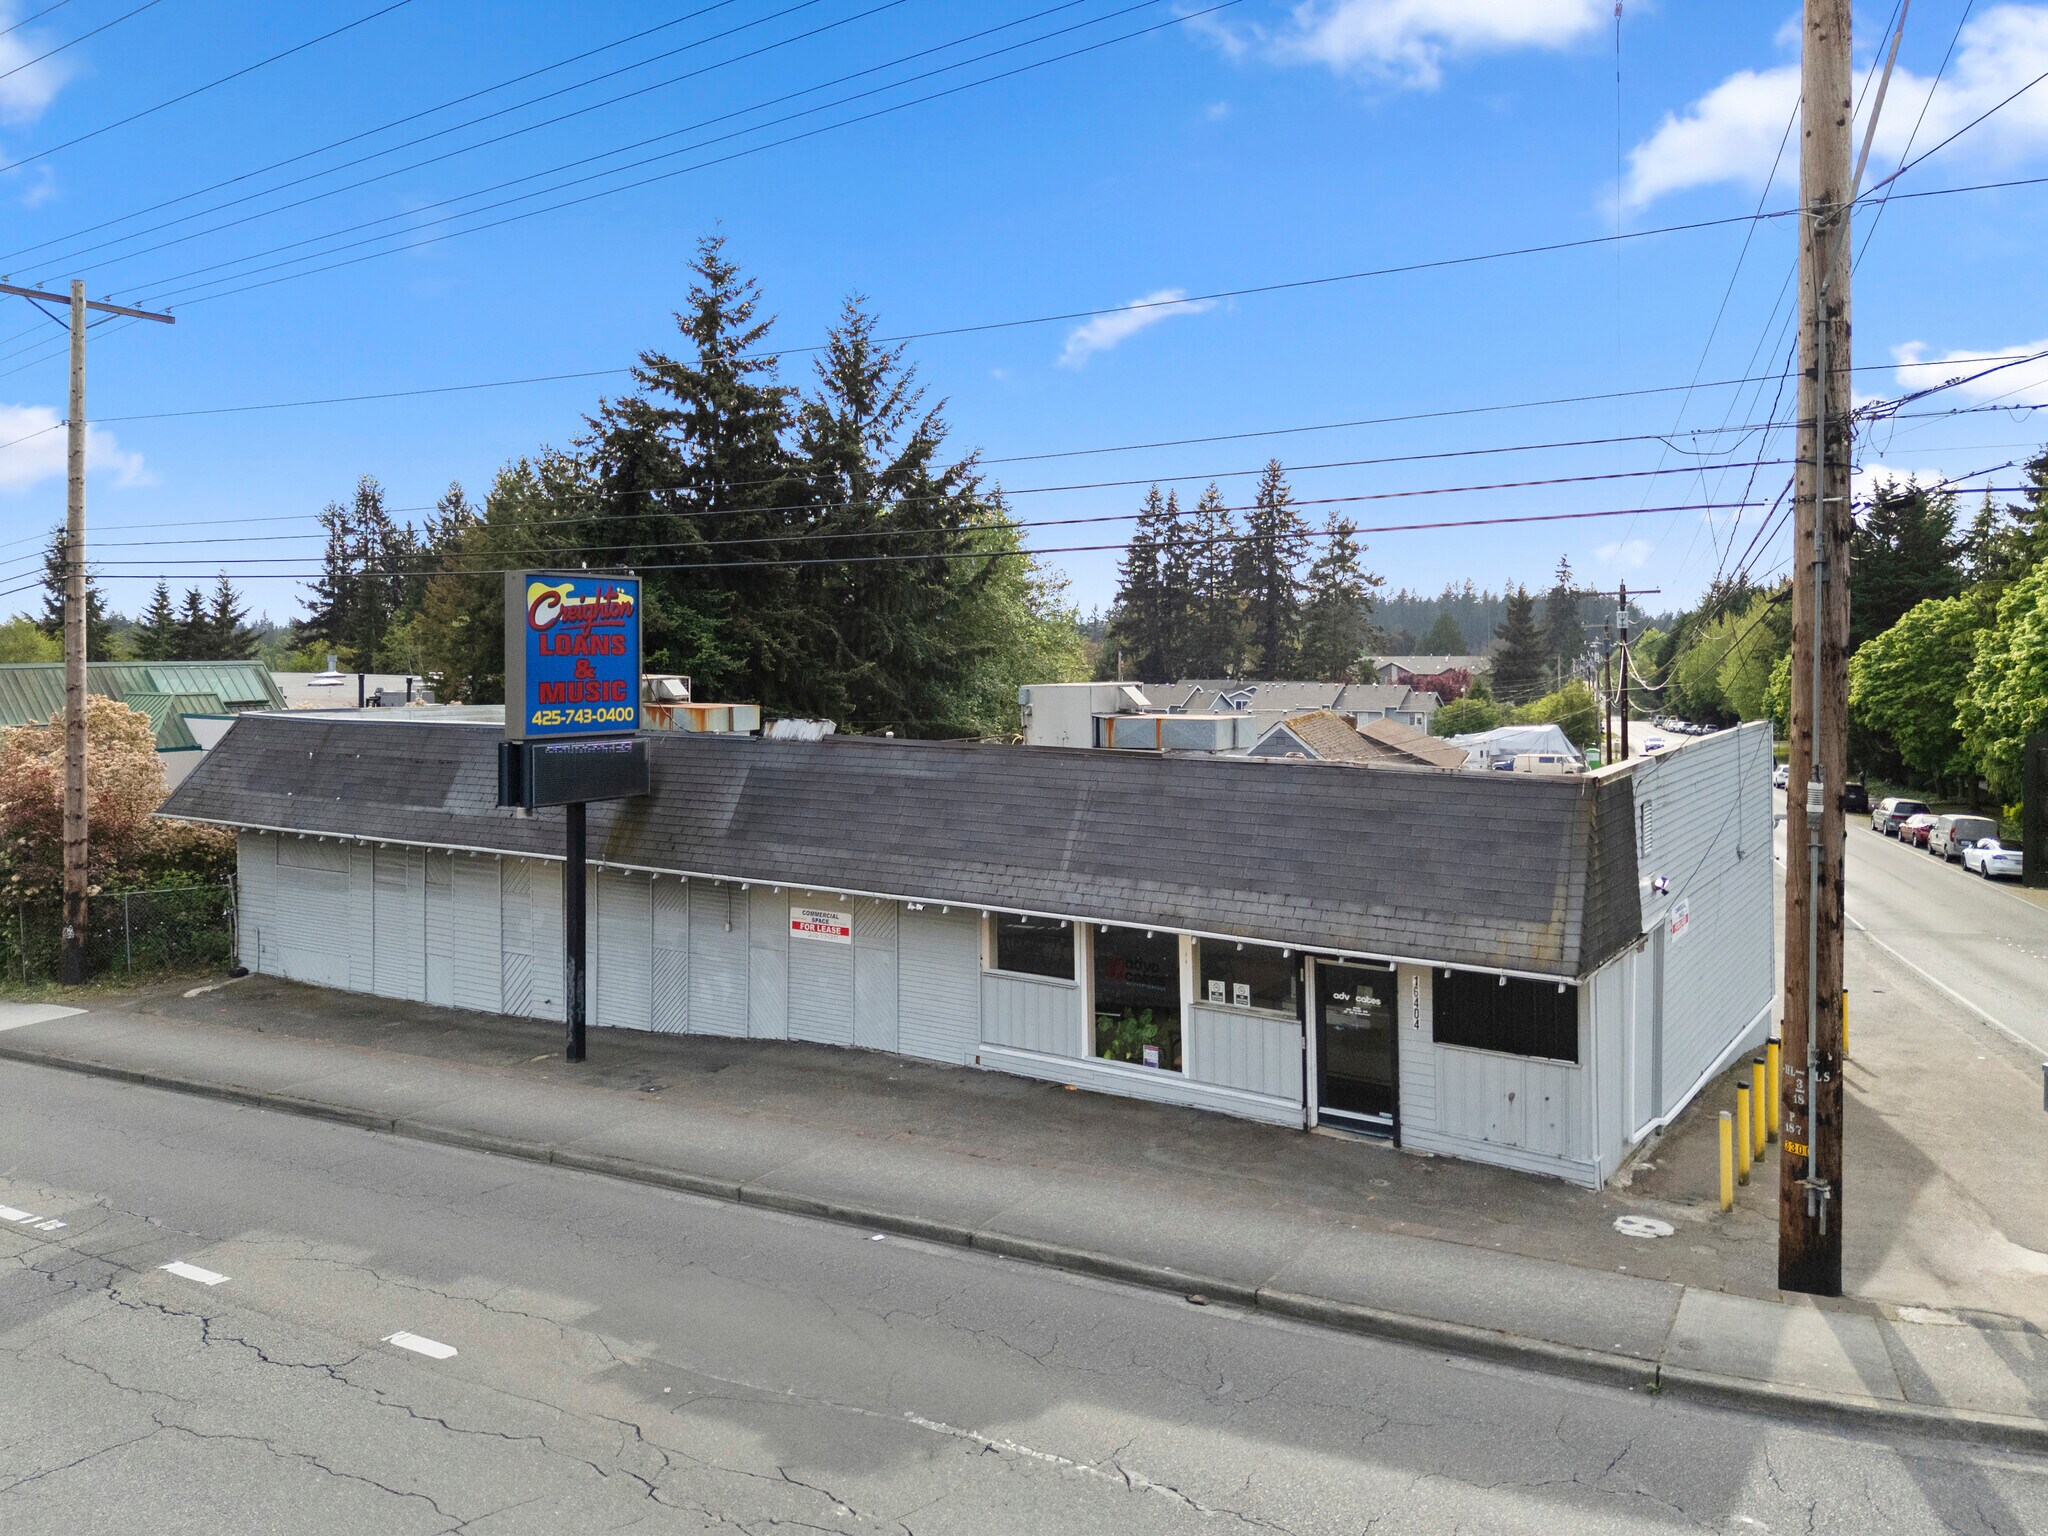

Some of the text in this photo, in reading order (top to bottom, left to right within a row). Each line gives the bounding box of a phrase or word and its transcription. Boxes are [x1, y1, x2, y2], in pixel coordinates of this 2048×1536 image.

[529, 585, 635, 639] Creighton
[539, 634, 627, 657] LOANS
[574, 659, 596, 679] &
[538, 680, 627, 704] MUSIC
[532, 707, 634, 726] 425-743-0400
[802, 910, 839, 919] COMMERCIAL
[800, 923, 841, 934] FOR LEASE
